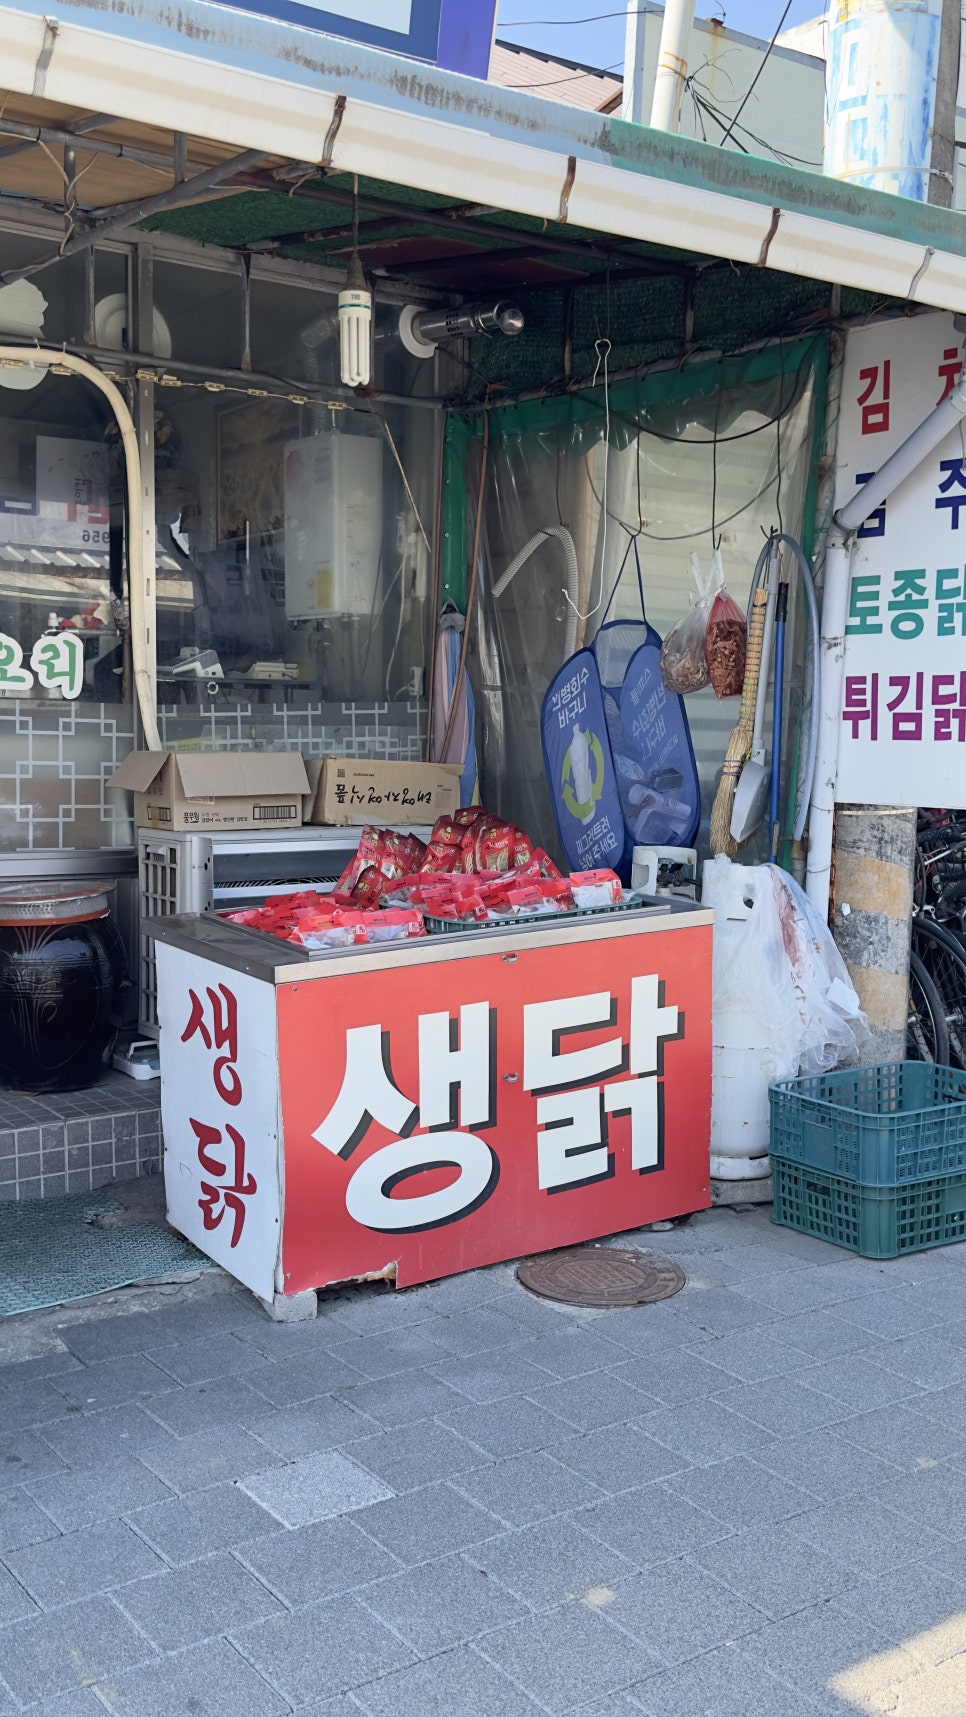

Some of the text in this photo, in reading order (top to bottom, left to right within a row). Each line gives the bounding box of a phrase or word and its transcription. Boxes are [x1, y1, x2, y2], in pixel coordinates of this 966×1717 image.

[857, 360, 890, 435] 김
[551, 667, 590, 712] 빈병회수
[558, 691, 587, 729] 바구니
[842, 671, 966, 742] 튀김닭
[592, 832, 619, 861] 주세요
[180, 982, 258, 1249] 생닭
[311, 973, 685, 1234] 생닭
